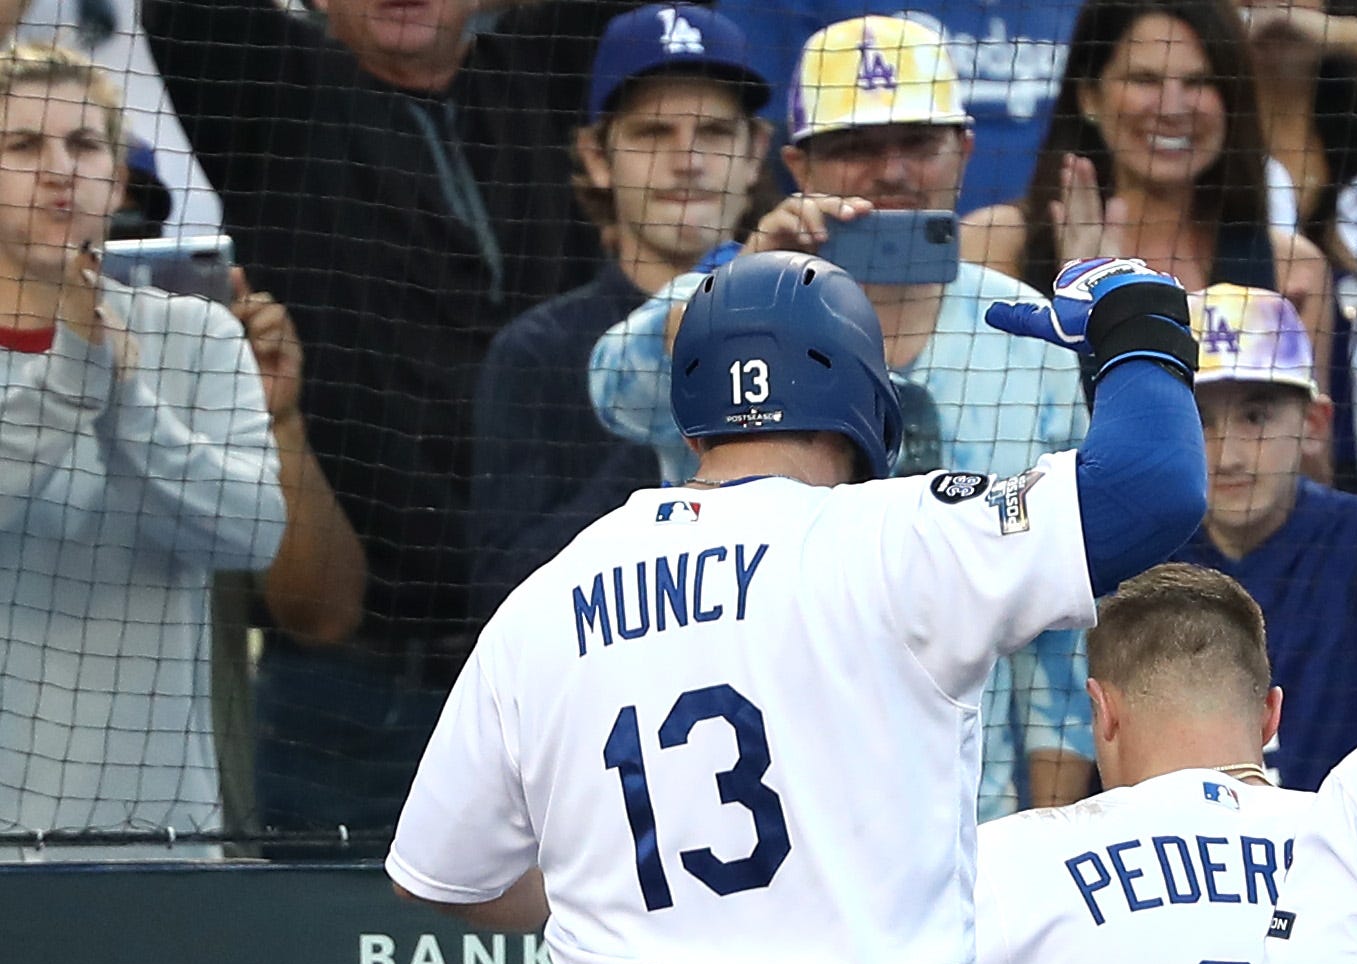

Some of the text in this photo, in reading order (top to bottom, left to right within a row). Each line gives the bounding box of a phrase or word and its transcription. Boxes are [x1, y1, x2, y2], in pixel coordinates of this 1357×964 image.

[729, 359, 769, 404] 13
[572, 544, 770, 658] MUNCY
[603, 683, 792, 912] 13
